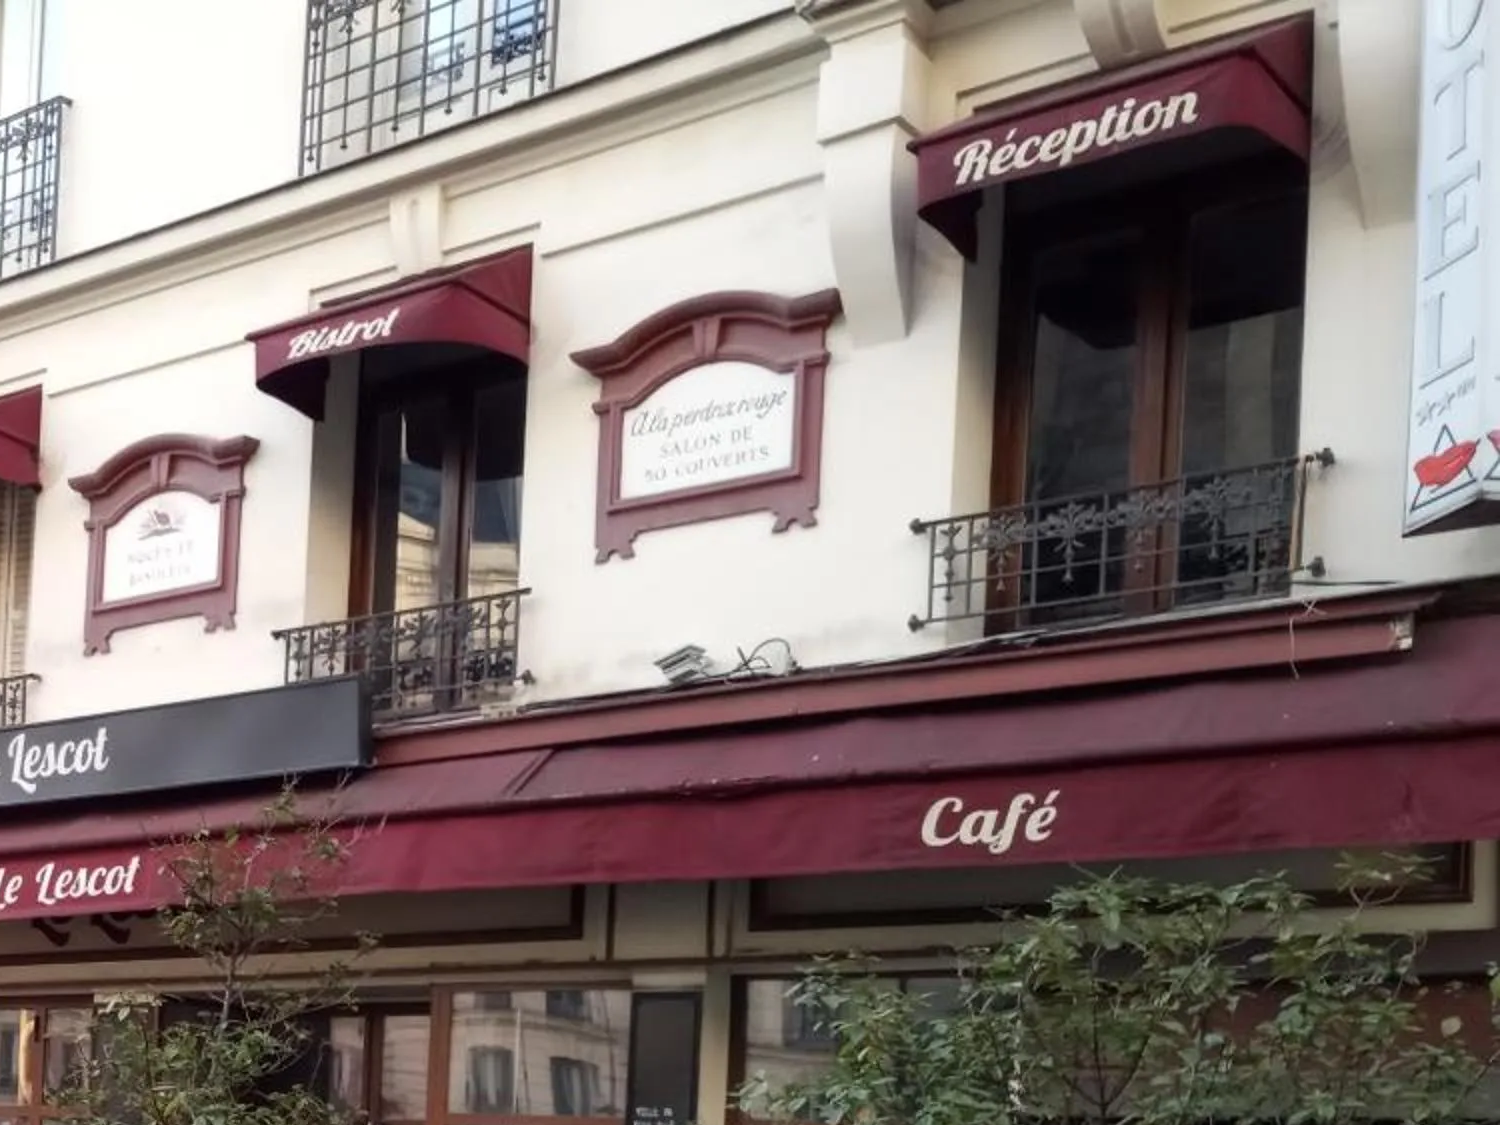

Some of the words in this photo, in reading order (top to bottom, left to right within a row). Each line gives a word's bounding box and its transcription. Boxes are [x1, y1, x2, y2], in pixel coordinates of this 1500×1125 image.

[953, 91, 1199, 186] Réception
[287, 307, 400, 360] Bistrot
[658, 431, 723, 459] SALON
[730, 425, 754, 446] DE
[674, 446, 771, 478] COUVERTS
[7, 726, 110, 795] Lescot
[920, 789, 1061, 855] Café
[34, 854, 142, 906] Lescot
